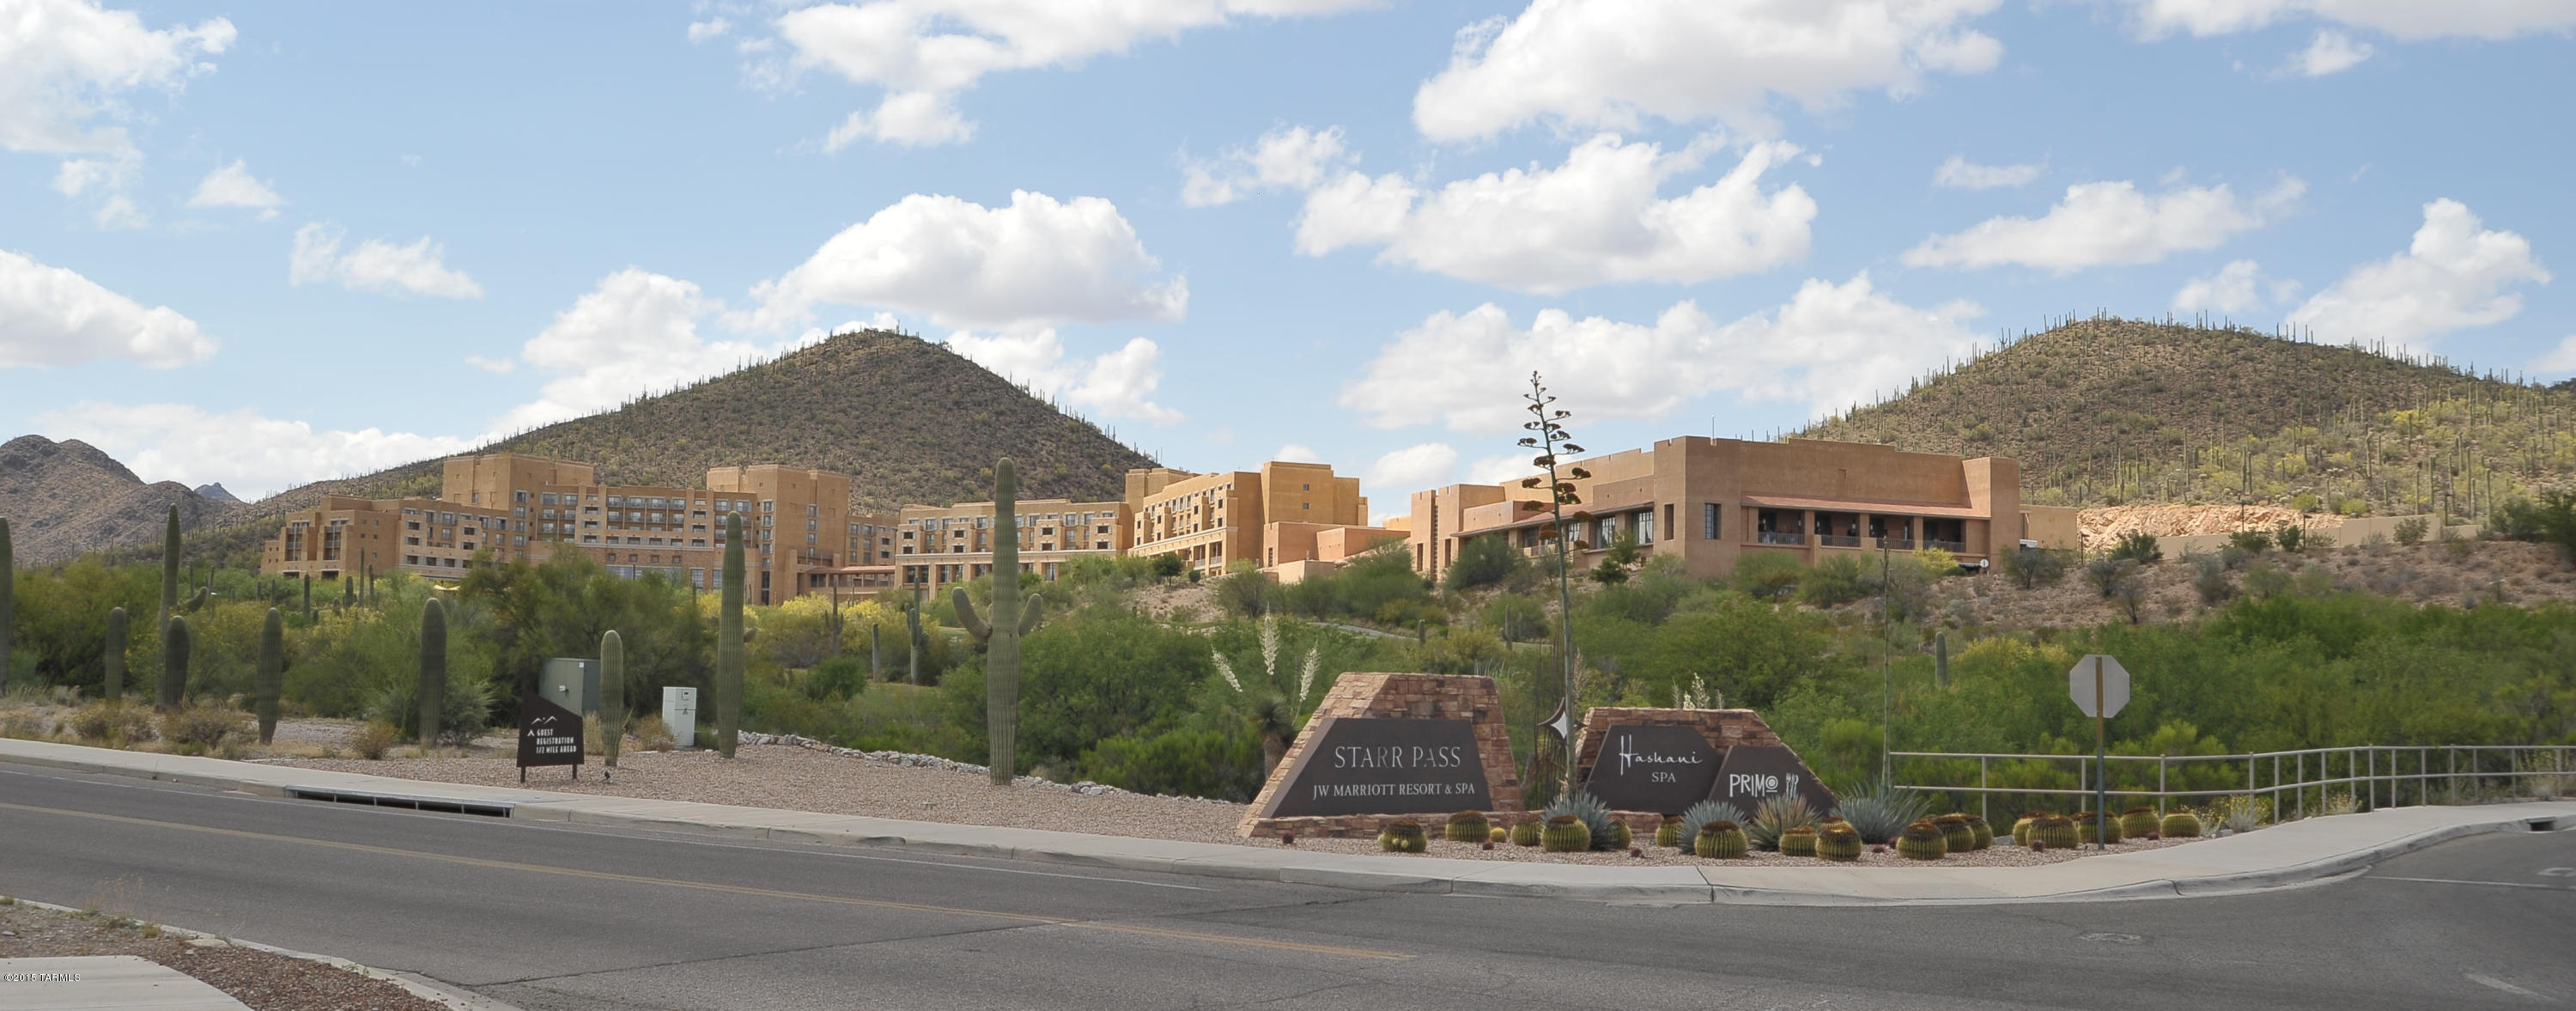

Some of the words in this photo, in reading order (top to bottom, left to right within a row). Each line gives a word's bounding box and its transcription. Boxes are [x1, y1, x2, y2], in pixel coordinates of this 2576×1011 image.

[1334, 746, 1403, 769] STARR
[1413, 746, 1461, 769] PASS
[1619, 734, 1703, 775] Hashani
[1651, 772, 1676, 783] SPA
[1729, 774, 1779, 797] PRIMO
[1313, 785, 1329, 801] JW
[1334, 784, 1395, 796] MARRIOTT
[1399, 783, 1442, 795] RESORT
[1444, 784, 1452, 795] &
[1455, 783, 1475, 795] SPA
